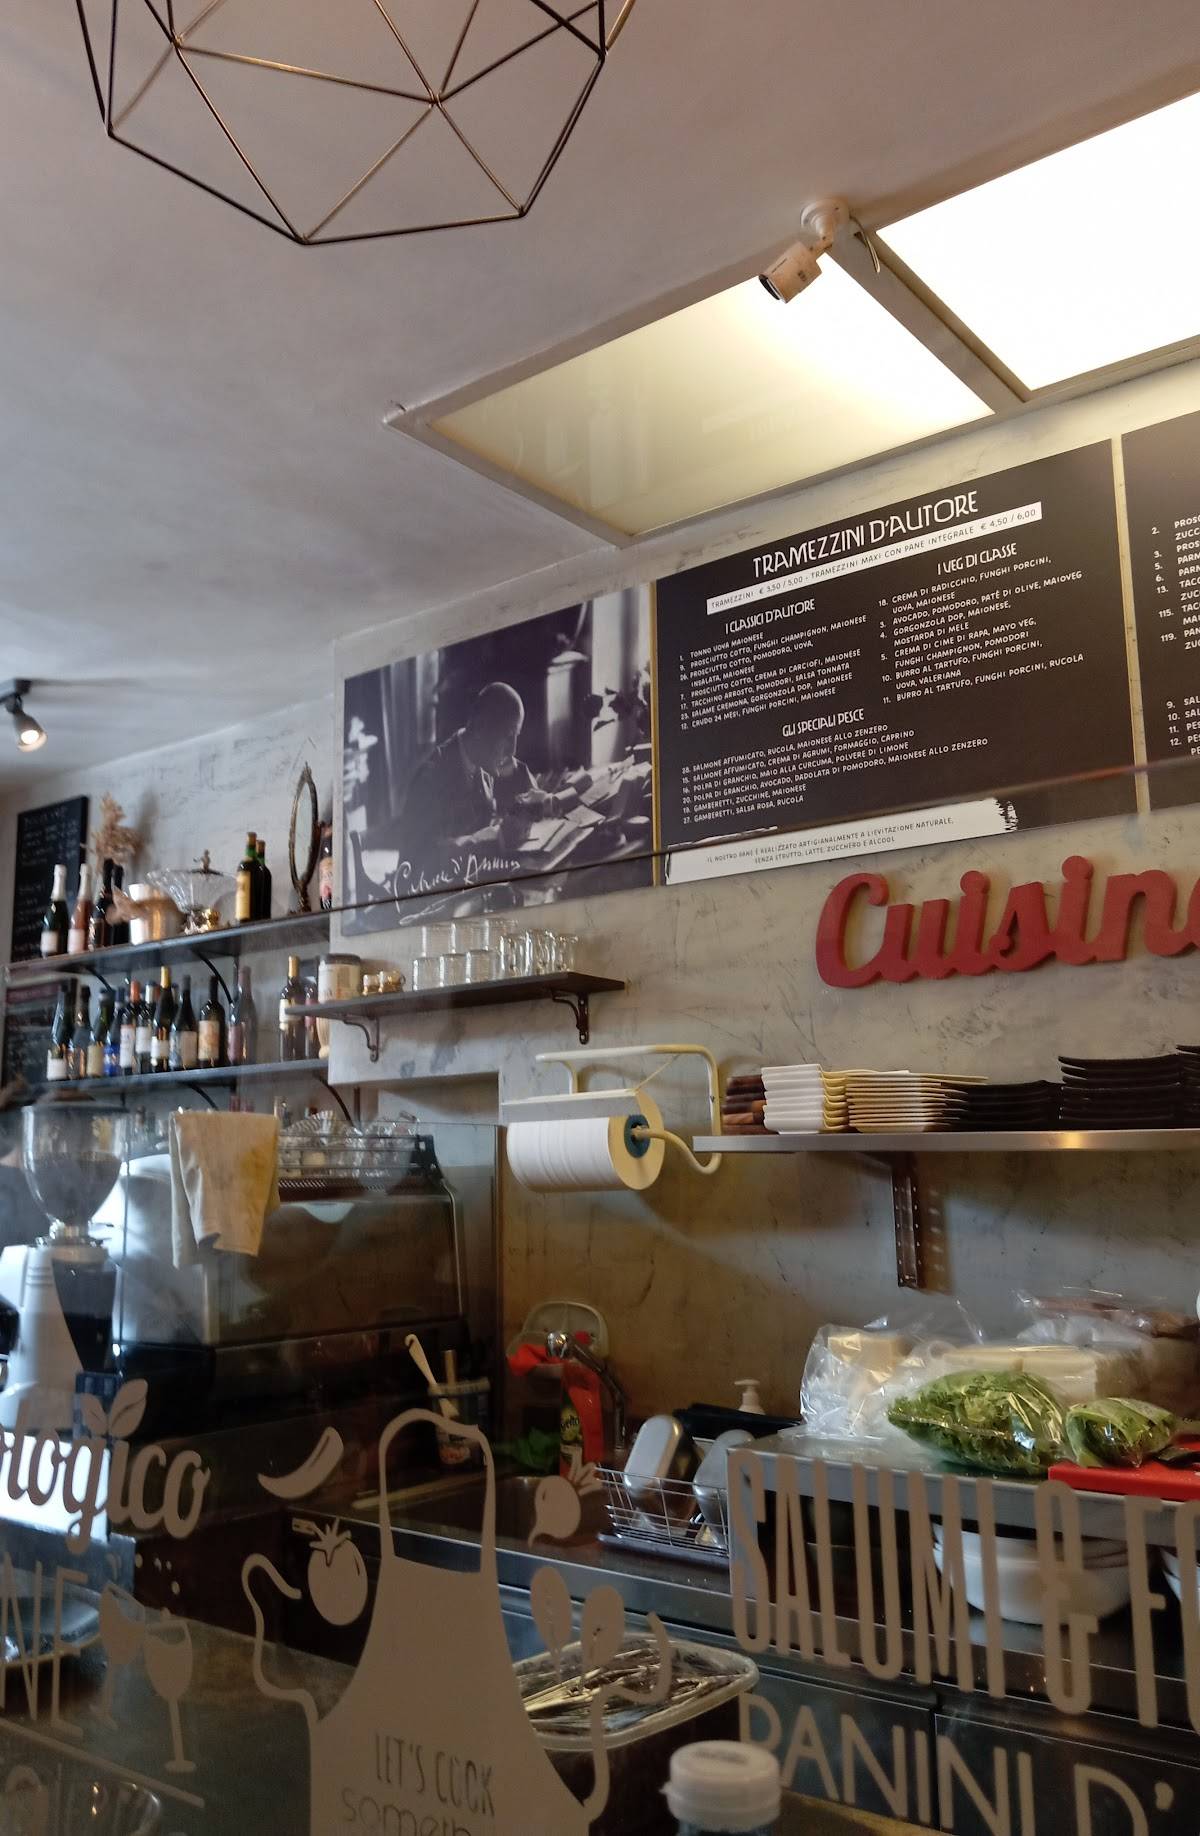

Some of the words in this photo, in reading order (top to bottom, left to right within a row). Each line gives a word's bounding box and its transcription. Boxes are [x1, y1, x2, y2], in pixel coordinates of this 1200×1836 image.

[752, 525, 865, 578] TRAMEZZINI
[868, 490, 979, 544] D'AUTORE
[1152, 526, 1160, 535] 2.
[942, 556, 964, 573] VEG
[965, 553, 978, 569] DI
[979, 542, 1017, 564] CLASSE
[1153, 550, 1163, 559] 3.
[1154, 562, 1163, 571] 5.
[878, 598, 889, 607] 18.
[891, 590, 918, 604] CREMA
[919, 587, 929, 597] DI
[979, 566, 1011, 581] FUNGHI
[1155, 574, 1164, 582] 6.
[879, 620, 887, 629] 3.
[1002, 588, 1012, 598] DI
[1043, 570, 1083, 587] MAIOVEG
[915, 591, 956, 609] MAIONESE
[1156, 585, 1169, 594] 13.
[729, 612, 764, 633] CLASSICI
[764, 598, 816, 624] D'AUTORE
[830, 614, 867, 632] MAIONESE
[1158, 608, 1175, 618] 115.
[879, 631, 888, 639] 4.
[893, 616, 946, 636] GORGONZOLA
[893, 630, 935, 647] MOSTARDA
[936, 628, 946, 637] DI
[948, 621, 969, 634] MELE
[1160, 632, 1177, 642] 119.
[880, 653, 888, 661] 5.
[894, 644, 921, 658] CREMA
[922, 642, 932, 651] DI
[933, 636, 955, 648] CIME
[956, 634, 966, 643] DI
[992, 622, 1017, 635] MAYO
[894, 655, 924, 669] FUNGHI
[984, 630, 1029, 648] POMODORI
[824, 648, 861, 665] MAIONESE
[881, 674, 892, 683] 10.
[895, 667, 921, 680] BURRO
[922, 664, 933, 674] AL
[972, 648, 1003, 663] FUNGHI
[795, 670, 816, 682] SALSA
[816, 661, 850, 676] TONNATA
[816, 671, 853, 688] MAIONESE
[882, 696, 891, 704] 11.
[896, 689, 922, 702] BURRO
[923, 686, 934, 696] AL
[974, 671, 1006, 685] FUNGHI
[1049, 653, 1084, 668] RUCOLA
[918, 668, 962, 685] VALERIANA
[800, 686, 836, 702] MAIONESE
[1166, 700, 1176, 709] 9.
[782, 723, 796, 737] GLI
[797, 714, 836, 735] SPECIALI
[837, 708, 865, 726] PESCE
[1167, 712, 1181, 721] 10.
[796, 735, 833, 750] MAIONESE
[833, 731, 853, 742] ALLO
[854, 724, 889, 738] ZENZERO
[880, 729, 915, 743] CAPRINO
[1170, 737, 1182, 746] 12.
[794, 768, 831, 782] DADOLATA
[887, 748, 927, 764] MAIONESE
[928, 745, 949, 756] ALLO
[951, 737, 988, 752] ZENZERO
[835, 749, 866, 763] POLVERE
[879, 741, 909, 755] LIMONE
[815, 855, 1200, 988] Cuisin
[0, 1395, 212, 1556] logico
[727, 1448, 1007, 1699] SALUMI
[1034, 1479, 1099, 1715] &
[374, 1731, 425, 1794] LET'S
[738, 1690, 1035, 1836] PANINI
